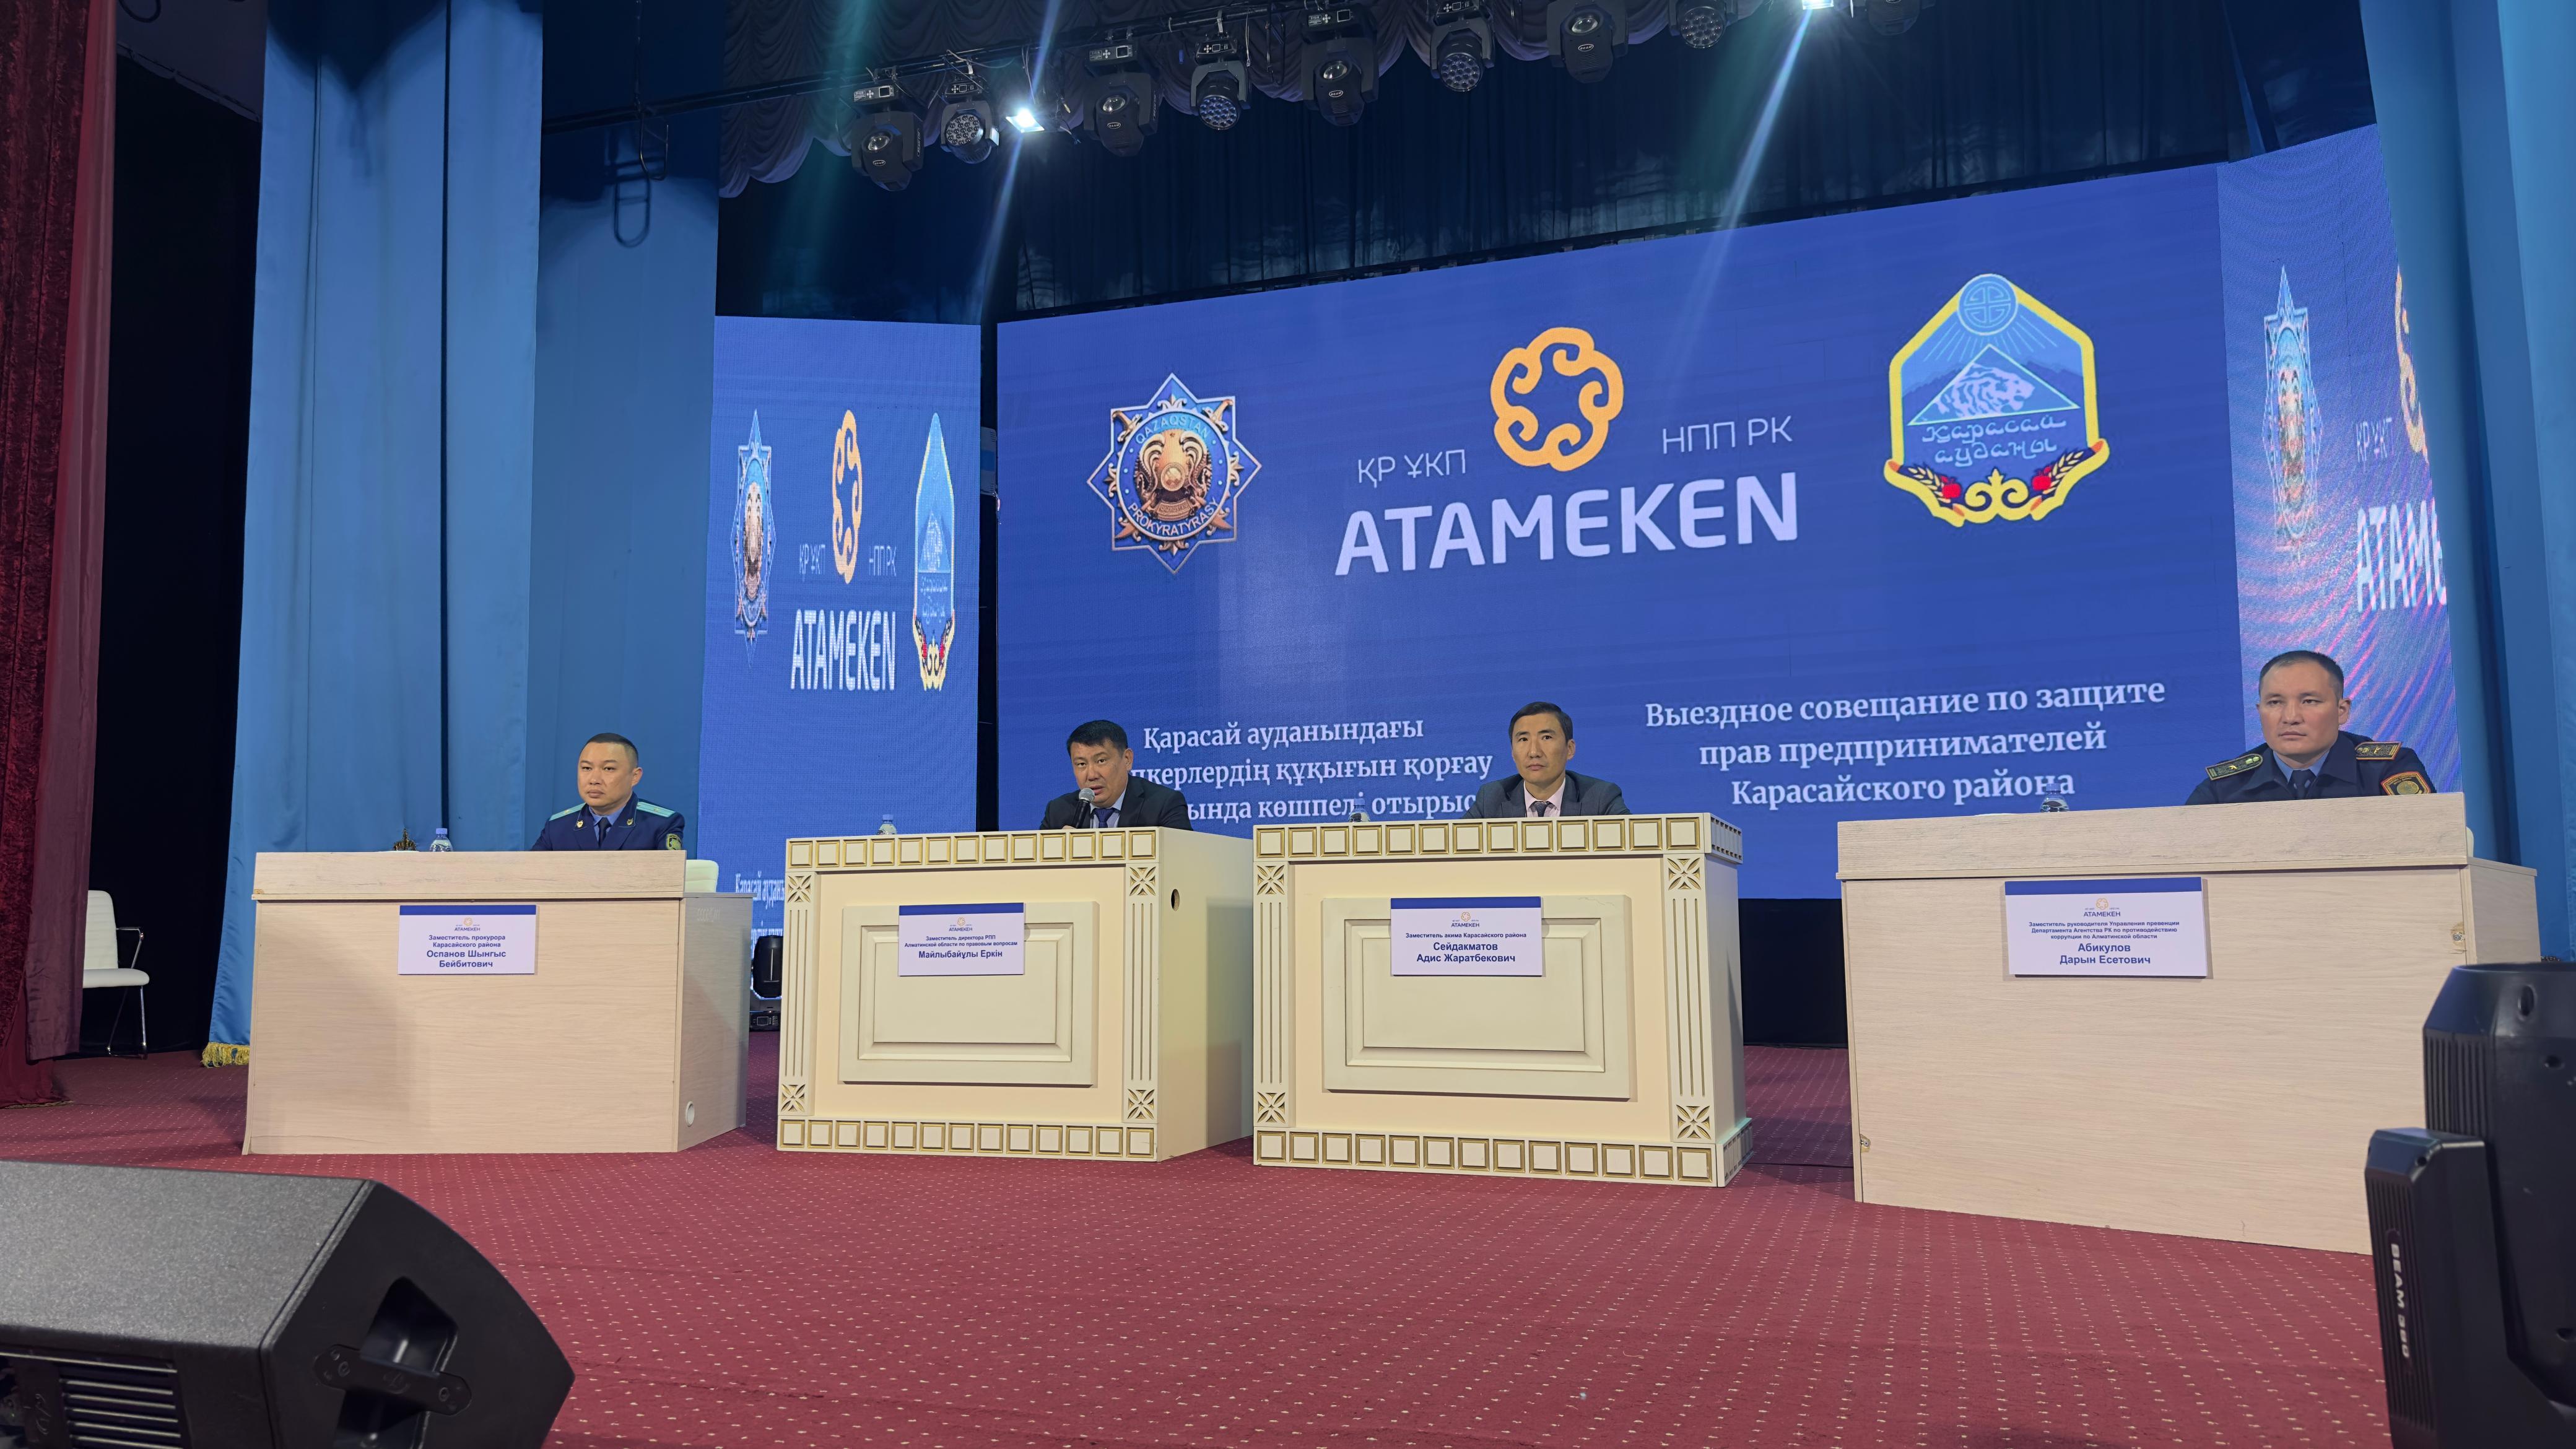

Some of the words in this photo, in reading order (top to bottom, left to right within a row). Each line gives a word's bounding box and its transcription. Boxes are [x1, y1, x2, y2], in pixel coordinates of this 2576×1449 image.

[1136, 415, 1209, 445] QAZAQSTAN
[1663, 422, 1736, 455] НПП
[1747, 416, 1793, 446] РК
[1357, 456, 1396, 488] ҚР
[1407, 450, 1466, 479] ҰКП
[1335, 472, 1797, 576] ATAMEKEN
[791, 609, 896, 691] ATAMEKEN
[1645, 703, 1793, 729] Выездное
[1799, 694, 1980, 723] совещание
[1987, 692, 2029, 711] по
[2035, 680, 2165, 710] защите
[1144, 722, 1241, 753] Қарасай
[1247, 719, 1424, 751] ауданындағы
[1700, 746, 1772, 771] прав
[1778, 723, 2107, 768] предпринимателей
[1276, 757, 1396, 786] құқығын
[1403, 755, 1493, 781] қорғау
[1258, 791, 1364, 818] көшпел
[1732, 773, 1946, 811] Карасайского
[1954, 768, 2075, 806] района
[918, 951, 978, 959] Майлыбайұлы
[980, 950, 1003, 959] Еркін
[1417, 954, 1441, 963] Адис
[1444, 954, 1515, 964] Жаратбекович
[1433, 942, 1498, 952] Сейдакматов
[2060, 955, 2096, 965] Дарын
[2099, 955, 2151, 964] Есетович
[2078, 943, 2131, 954] Абикулов
[2391, 1243, 2404, 1308] BEAM
